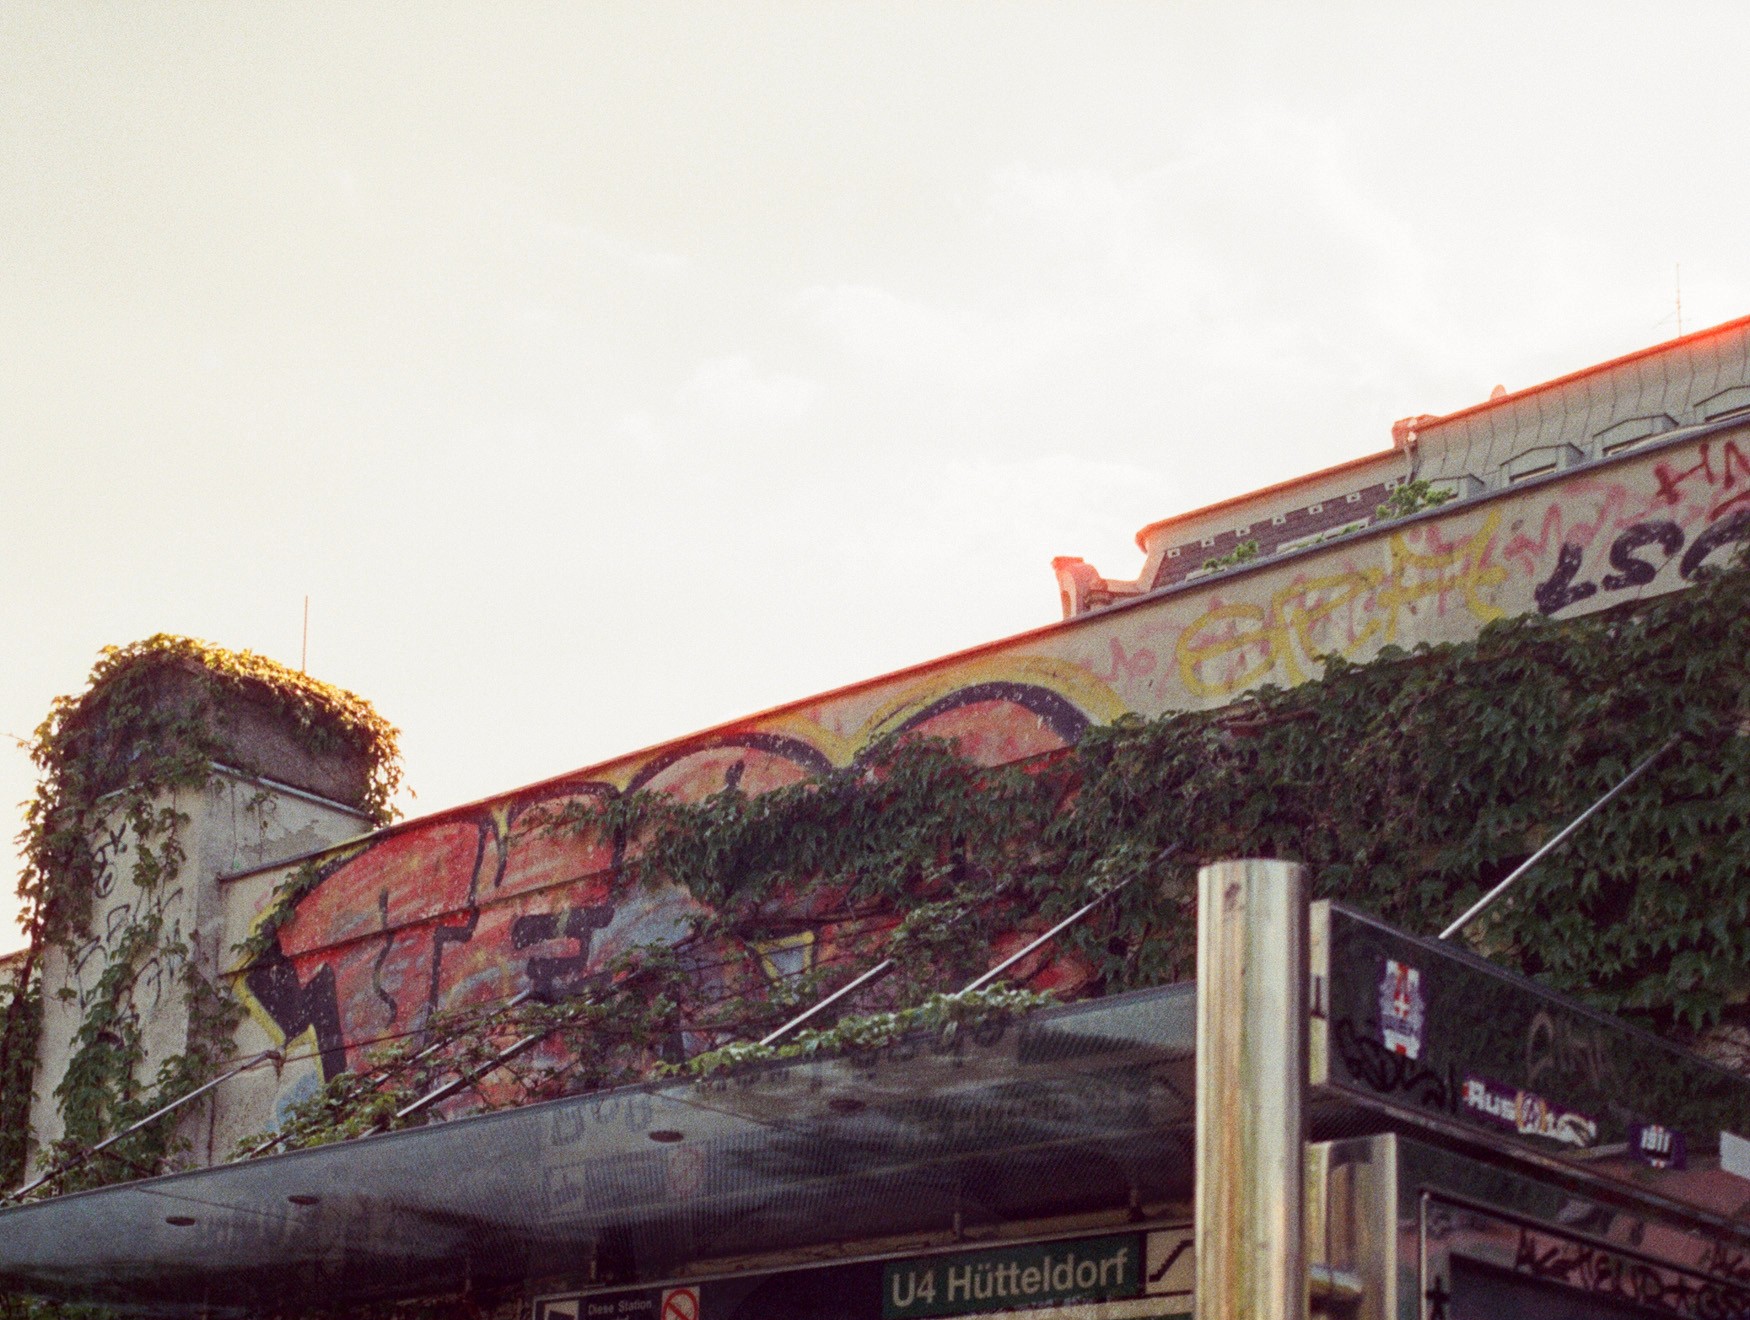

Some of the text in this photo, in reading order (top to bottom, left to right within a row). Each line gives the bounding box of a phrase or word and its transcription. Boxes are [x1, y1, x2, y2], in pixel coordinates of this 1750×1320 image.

[892, 1248, 1128, 1307] U4 Hütteldorf
[588, 1300, 652, 1315] Diese Station
